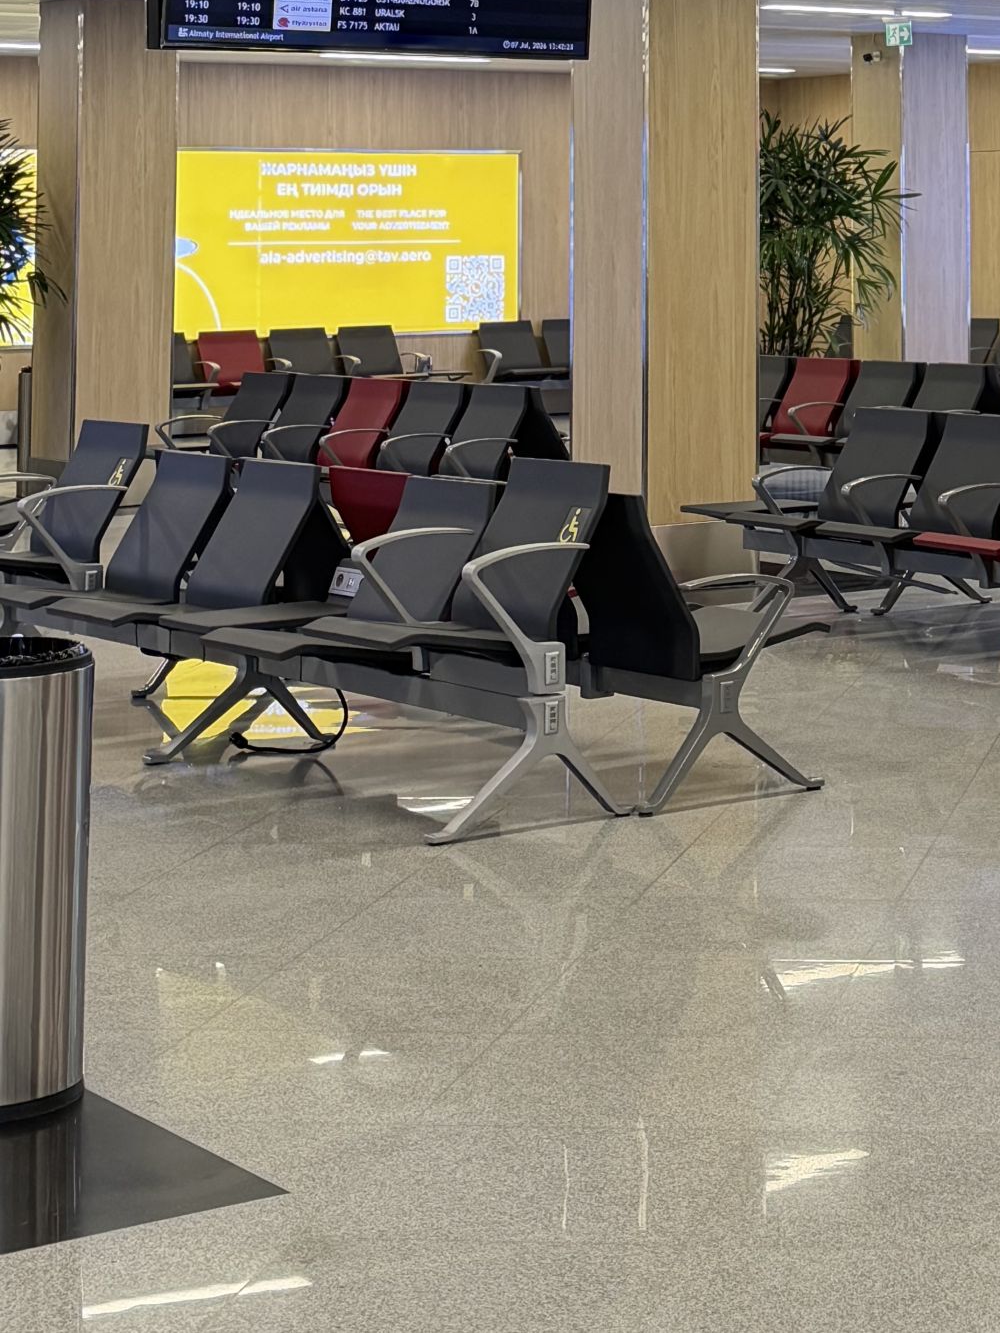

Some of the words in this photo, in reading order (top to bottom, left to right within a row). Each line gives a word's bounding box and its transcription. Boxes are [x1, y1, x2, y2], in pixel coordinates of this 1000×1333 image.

[185, 0, 209, 9] 19:10
[238, 2, 261, 12] 19:10
[470, 0, 479, 8] 7B
[339, 6, 351, 16] KC
[352, 7, 366, 16] 881
[375, 8, 405, 18] URALSK
[184, 14, 209, 24] 19:30
[237, 16, 260, 26] 19:30
[471, 12, 476, 21] 3
[337, 20, 347, 29] FS
[349, 20, 368, 30] 7175
[374, 22, 400, 31] AKTAU
[468, 26, 478, 35] 1A
[188, 30, 214, 39] Almaty
[215, 31, 259, 39] International
[260, 33, 284, 42] Airport
[262, 162, 375, 177] ЖАРНАМАҢЫЗ
[379, 164, 417, 176] ҮШІН
[276, 184, 299, 197] ЕҢ
[302, 184, 353, 197] ТИІМДІ
[357, 185, 402, 196] ОРЫН
[356, 210, 374, 218] THE
[376, 210, 397, 218] BEST
[399, 210, 427, 218] PLACE
[352, 222, 377, 230] YOUR
